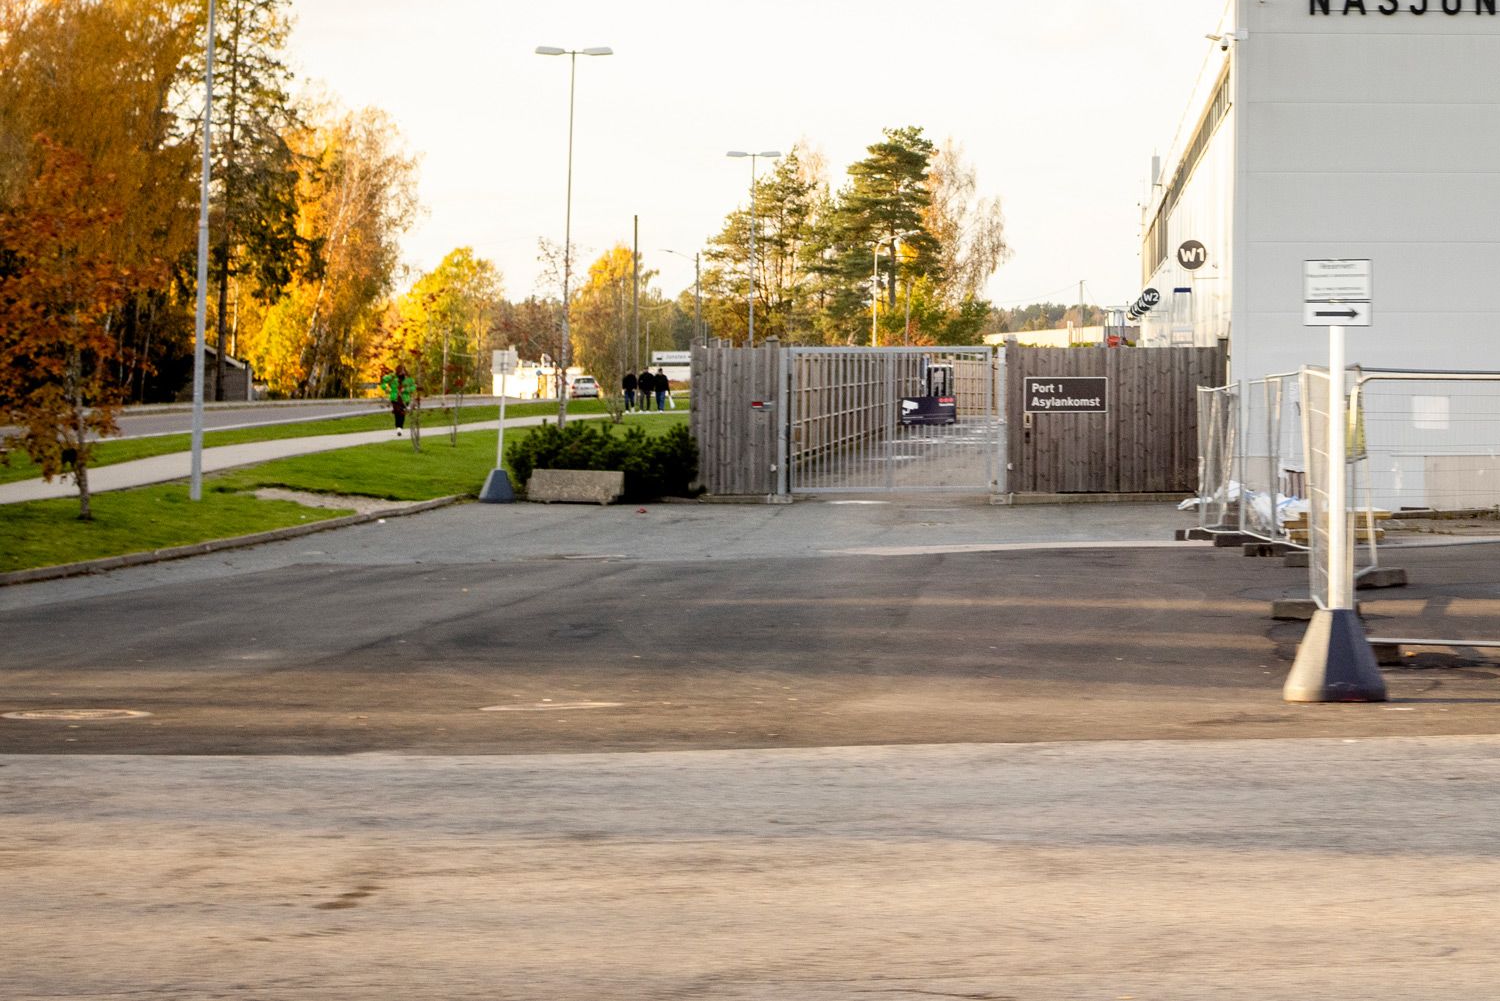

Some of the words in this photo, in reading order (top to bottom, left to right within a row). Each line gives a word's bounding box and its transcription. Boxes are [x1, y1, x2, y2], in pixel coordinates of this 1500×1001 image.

[1180, 247, 1205, 263] W1
[1143, 292, 1159, 302] W2
[1031, 383, 1055, 393] Port
[1058, 384, 1063, 393] 1
[1031, 396, 1101, 409] Asylankomst
